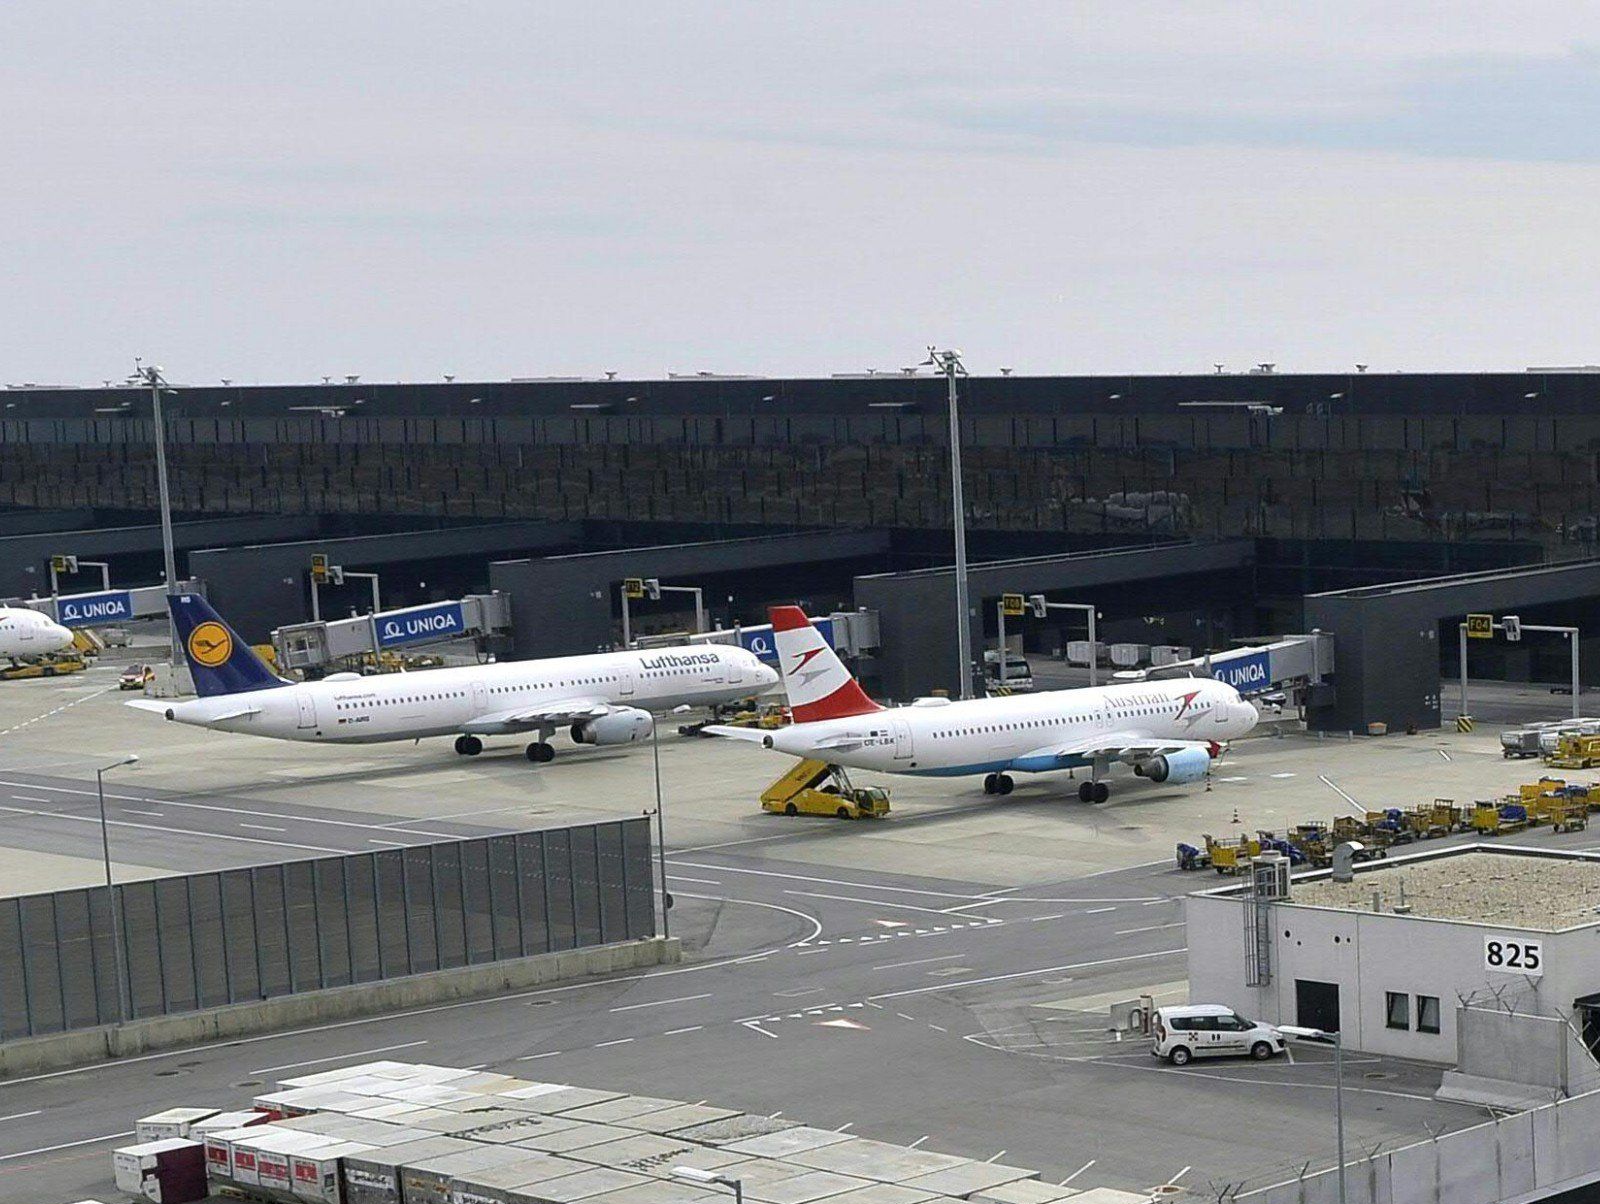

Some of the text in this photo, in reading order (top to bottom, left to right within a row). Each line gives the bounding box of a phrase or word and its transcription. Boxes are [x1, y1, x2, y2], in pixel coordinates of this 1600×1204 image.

[83, 601, 125, 618] UNIQA
[407, 613, 457, 635] UNIQA
[1469, 619, 1489, 629] F04
[640, 652, 720, 671] Lufthansa
[1230, 662, 1266, 686] UNIQA
[1103, 691, 1170, 711] Austrian
[1487, 941, 1540, 970] 825
